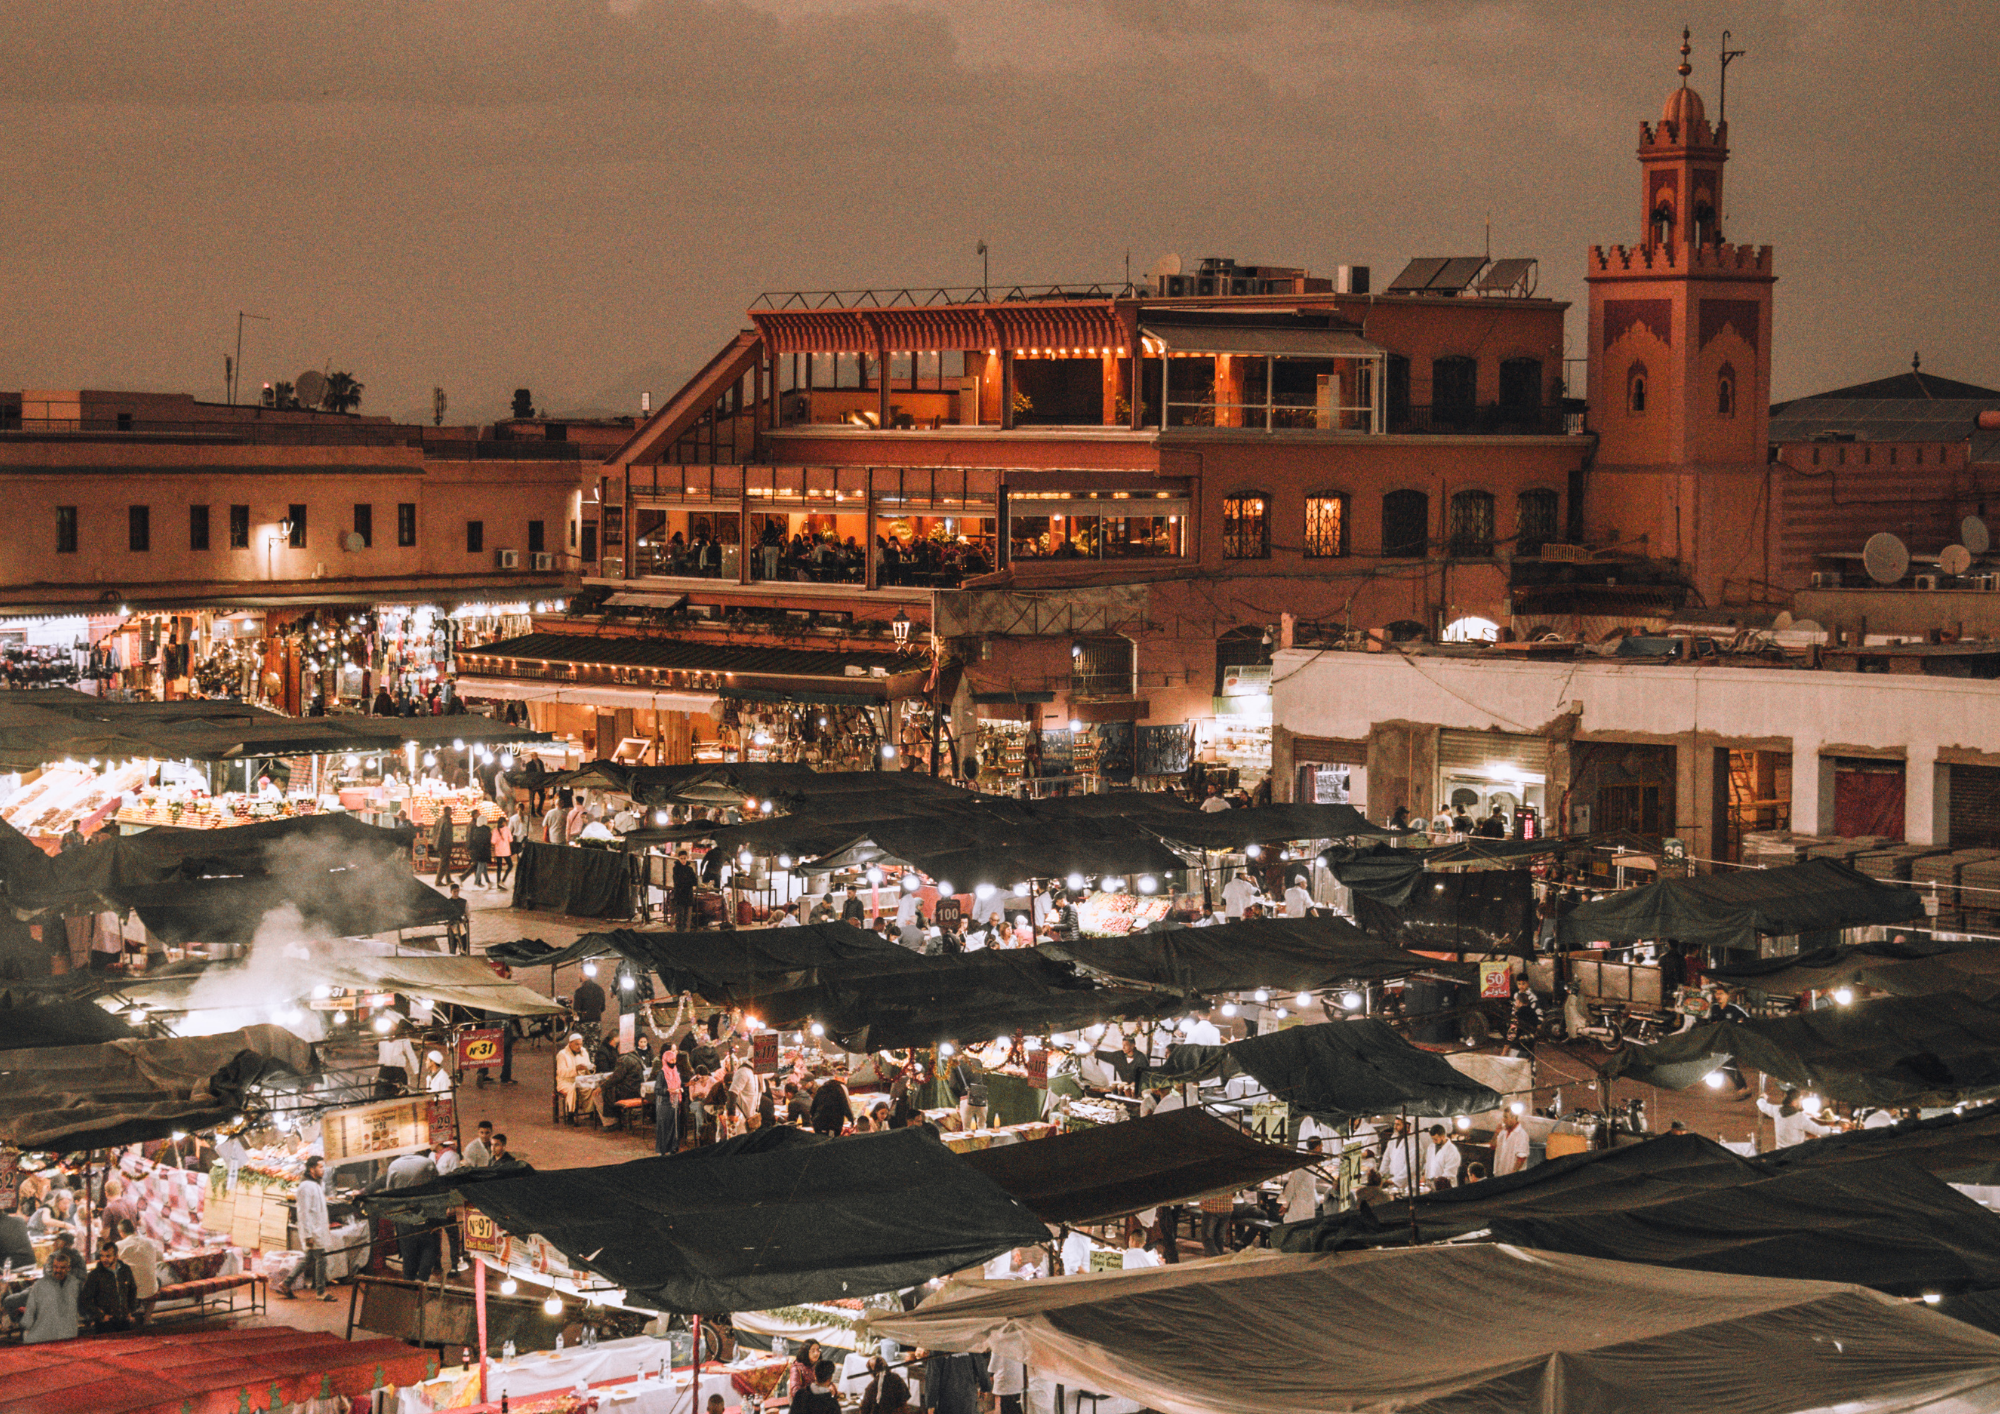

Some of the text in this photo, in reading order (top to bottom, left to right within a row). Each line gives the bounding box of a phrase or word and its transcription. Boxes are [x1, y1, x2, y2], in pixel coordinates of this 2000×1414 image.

[938, 907, 959, 921] 100
[1487, 973, 1503, 985] 50
[469, 1043, 494, 1056] N°31
[469, 1218, 491, 1238] N°97
